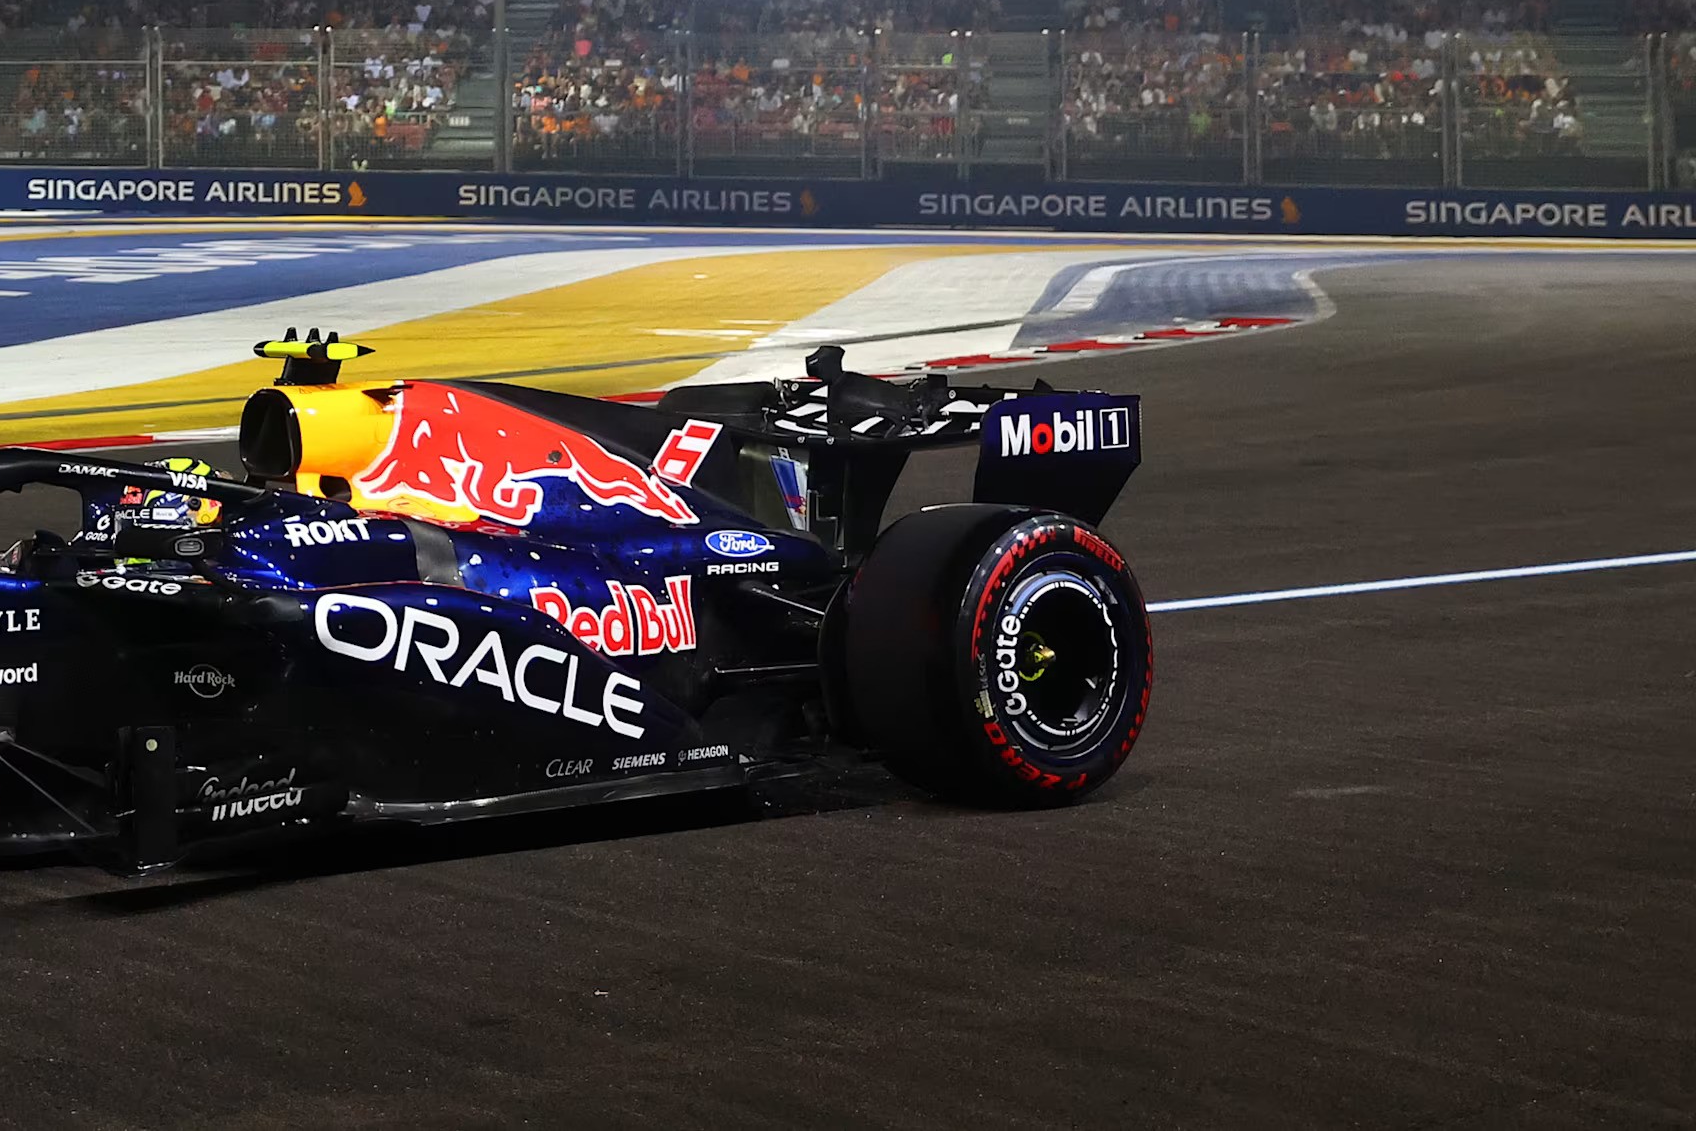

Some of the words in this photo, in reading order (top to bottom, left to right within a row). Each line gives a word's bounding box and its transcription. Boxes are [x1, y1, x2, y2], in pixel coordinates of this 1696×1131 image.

[28, 178, 194, 203] SINGAPORE
[205, 181, 341, 204] AIRLINES
[458, 185, 635, 209] SINGAPORE
[648, 188, 791, 213] AIRLINES
[919, 193, 1106, 218] SINGAPORE
[1120, 196, 1272, 221] AIRLINES
[1406, 201, 1606, 227] SINGAPORE
[1621, 204, 1696, 228] AIRL
[1000, 409, 1095, 458] Mobil
[653, 419, 723, 489] 6
[58, 463, 120, 478] DAMAC
[169, 471, 208, 492] VISA
[284, 518, 371, 548] ROKT
[719, 531, 776, 553] Ford
[707, 562, 780, 576] RACING
[530, 579, 635, 658] Red
[628, 575, 696, 657] Bull
[174, 671, 206, 685] Hard
[207, 671, 236, 688] Rock
[314, 593, 646, 740] ORACLE
[611, 752, 666, 771] SIEMENS
[687, 745, 729, 761] HEXAGON
[545, 757, 594, 778] CLEAR
